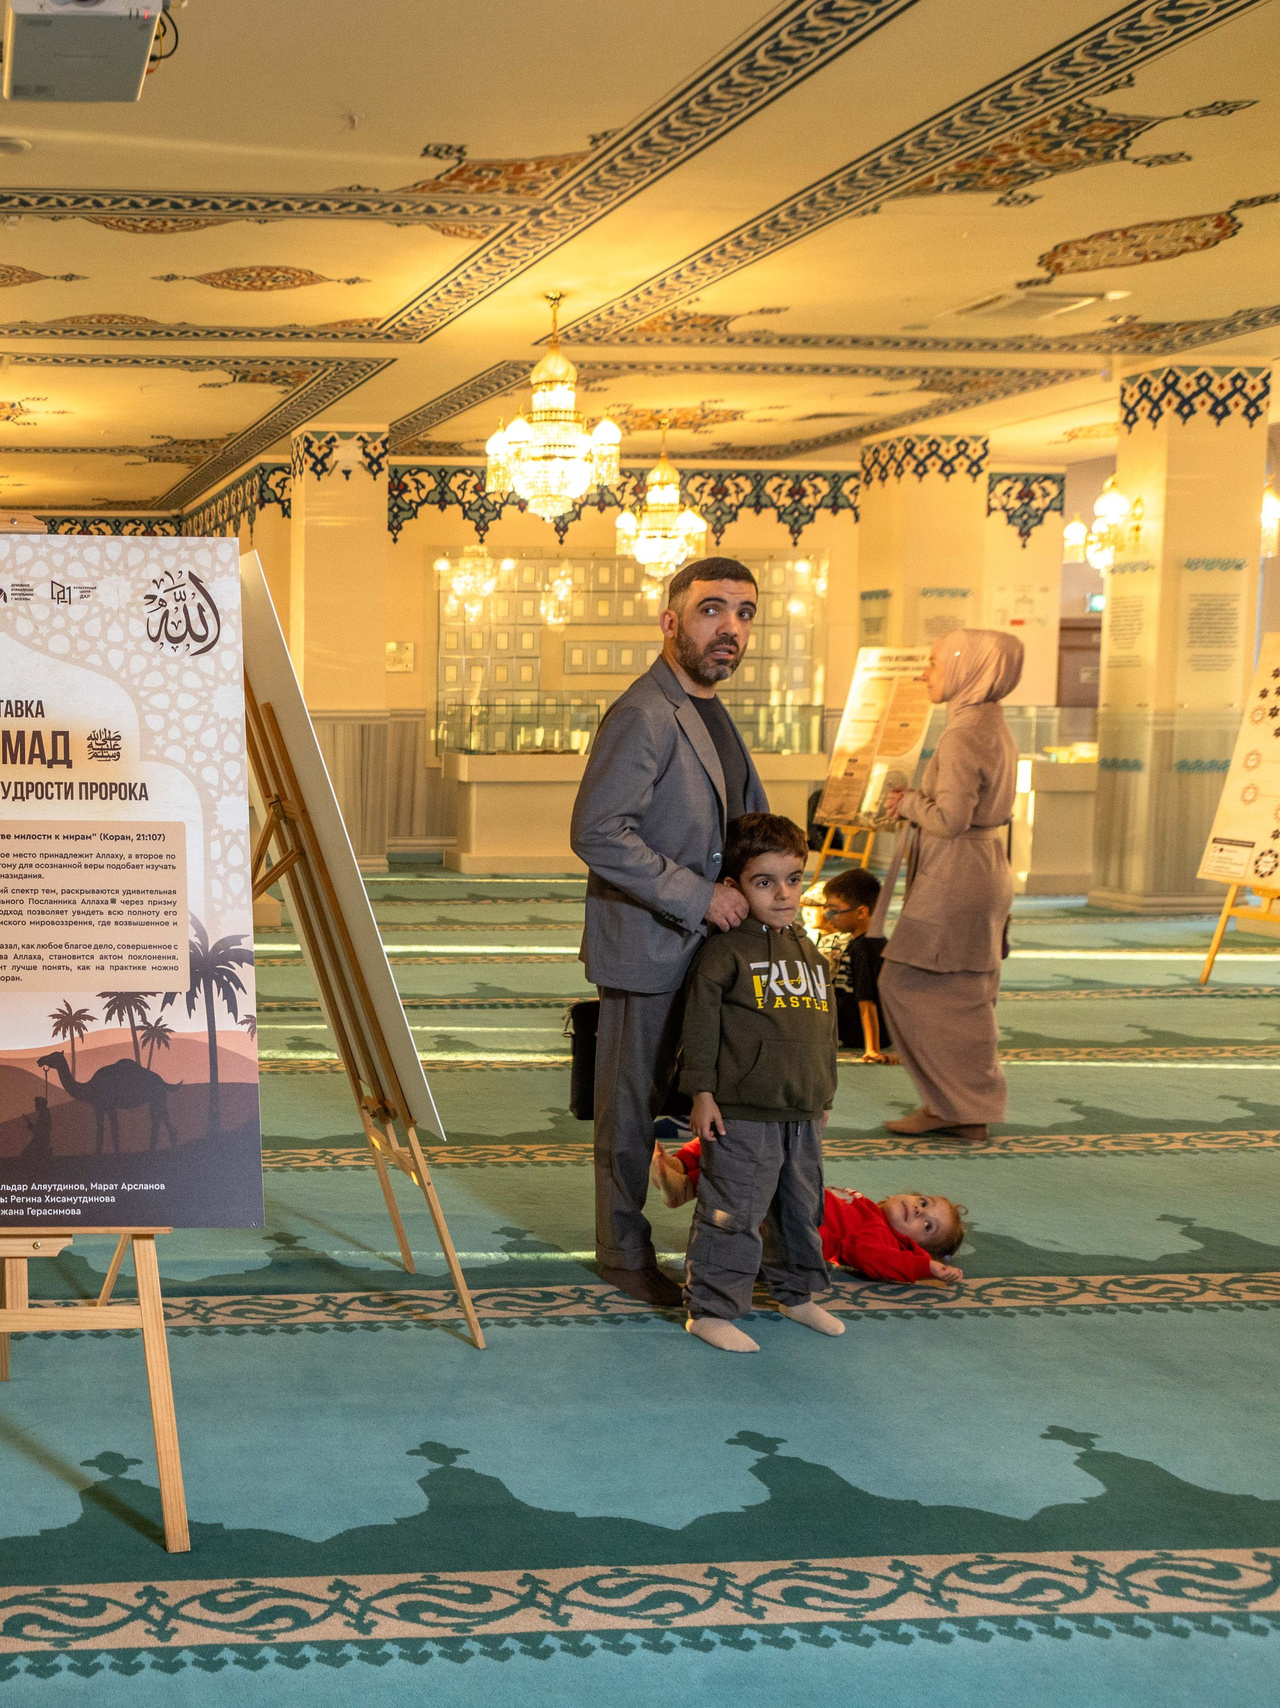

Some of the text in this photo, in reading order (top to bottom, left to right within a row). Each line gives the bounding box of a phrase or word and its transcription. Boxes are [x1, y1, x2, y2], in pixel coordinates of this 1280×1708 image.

[79, 782, 149, 802] ПРОРОКА
[100, 831, 133, 843] (Коран,
[136, 831, 165, 843] 21:107)
[40, 852, 93, 861] принадлежит
[96, 850, 125, 861] Аллаху,
[135, 853, 163, 861] второе
[18, 863, 33, 872] для
[35, 861, 82, 870] осознанной
[84, 863, 104, 872] веры
[106, 861, 144, 872] подобает
[146, 864, 176, 872] изучать
[0, 873, 44, 882] назидания.
[11, 888, 39, 897] спектр
[41, 888, 58, 897] тем,
[61, 888, 119, 897] раскрываются
[122, 889, 176, 897] удивительная
[29, 896, 76, 905] Посланника
[81, 896, 109, 905] Аллаха
[120, 899, 144, 907] через
[148, 899, 177, 908] призму
[72, 909, 104, 918] увидеть
[128, 909, 160, 918] полноту
[30, 920, 94, 928] мировоззрения,
[98, 920, 111, 928] где
[36, 941, 63, 949] любое
[64, 941, 92, 950] благое
[93, 943, 115, 952] дело,
[117, 943, 172, 952] совершенное
[13, 951, 44, 962] Аллаха,
[11, 964, 37, 973] лучше
[42, 964, 72, 973] понять,
[110, 964, 146, 973] практике
[31, 1181, 87, 1192] Аляутдинов,
[91, 1181, 118, 1192] Марат
[121, 1181, 165, 1192] Арсланов
[11, 1193, 42, 1203] Регина
[45, 1193, 115, 1205] Хисамутдинова
[27, 1206, 81, 1218] Герасимова
